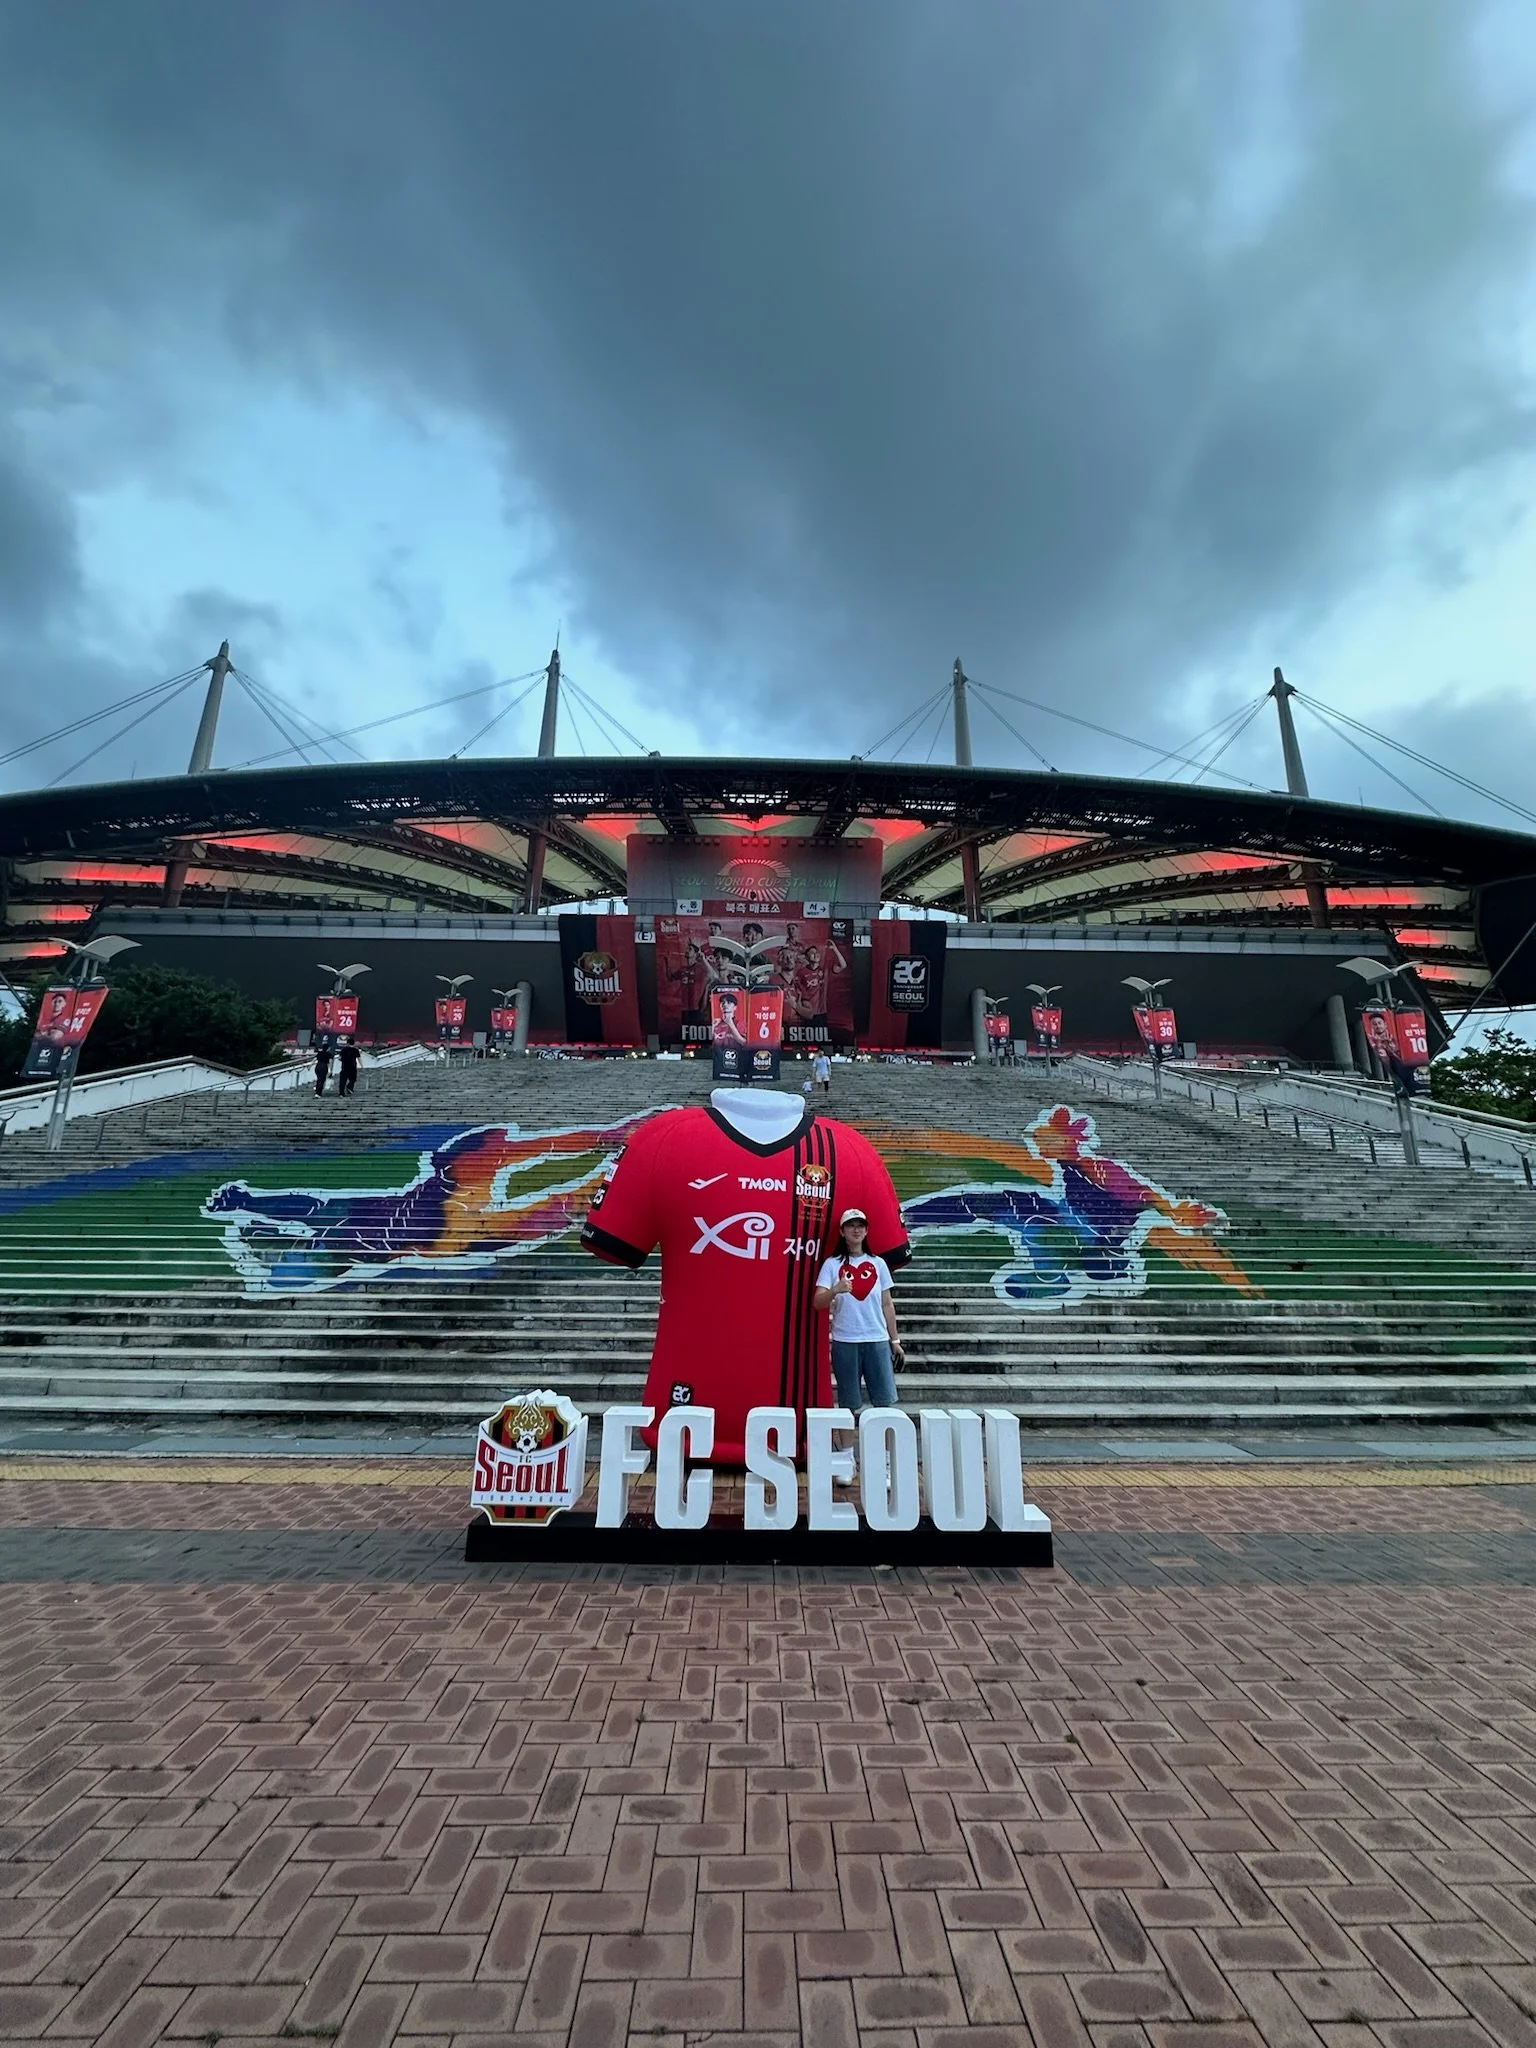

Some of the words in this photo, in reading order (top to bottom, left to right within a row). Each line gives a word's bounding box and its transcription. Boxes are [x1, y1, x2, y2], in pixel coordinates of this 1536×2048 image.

[715, 877, 755, 888] WORLD
[757, 877, 781, 888] CUP
[786, 878, 838, 889] STADIUM
[725, 903, 747, 914] 북측
[749, 903, 781, 914] 매표소
[809, 903, 818, 911] 서
[637, 931, 654, 941] (E)
[573, 967, 622, 993] Seoul
[892, 992, 925, 1000] SEOUL
[338, 1015, 353, 1027] 26
[681, 1024, 713, 1041] FOOT
[789, 1026, 832, 1042] SEOUL
[759, 1022, 770, 1039] 6
[1159, 1026, 1173, 1037] 30
[1409, 1037, 1428, 1053] 10
[753, 1056, 772, 1066] Seoul
[737, 1176, 786, 1192] TMON
[796, 1174, 831, 1200] Seoul
[783, 1237, 821, 1262] 자이
[474, 1438, 569, 1494] Seoul
[519, 1454, 532, 1464] FC
[595, 1406, 715, 1530] FC
[744, 1406, 1052, 1532] SEOUL
